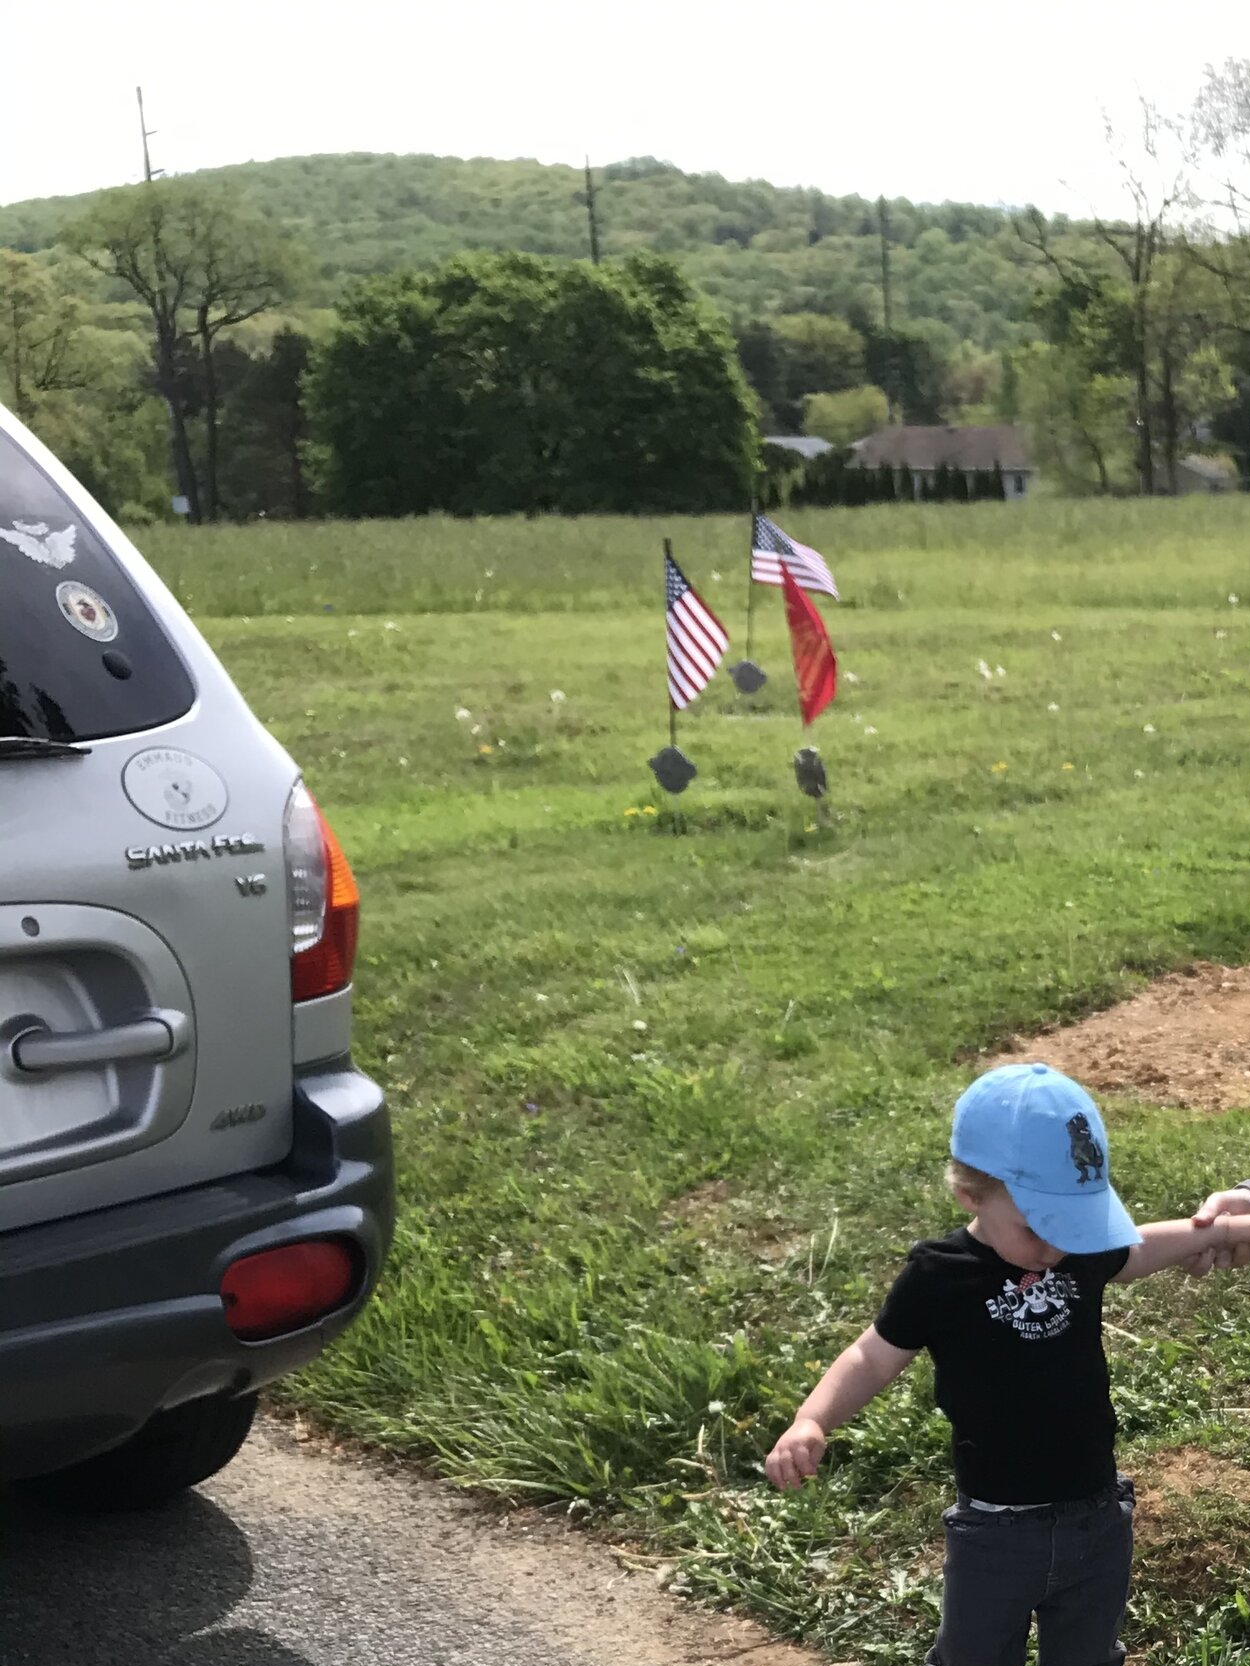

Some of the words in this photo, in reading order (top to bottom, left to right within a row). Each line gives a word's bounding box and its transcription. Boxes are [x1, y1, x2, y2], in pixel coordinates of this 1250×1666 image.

[125, 838, 211, 870] SANTA
[233, 872, 267, 898] V6
[209, 1102, 266, 1132] 4WD
[985, 1291, 1019, 1319] BAD
[1012, 1319, 1043, 1332] OUTER
